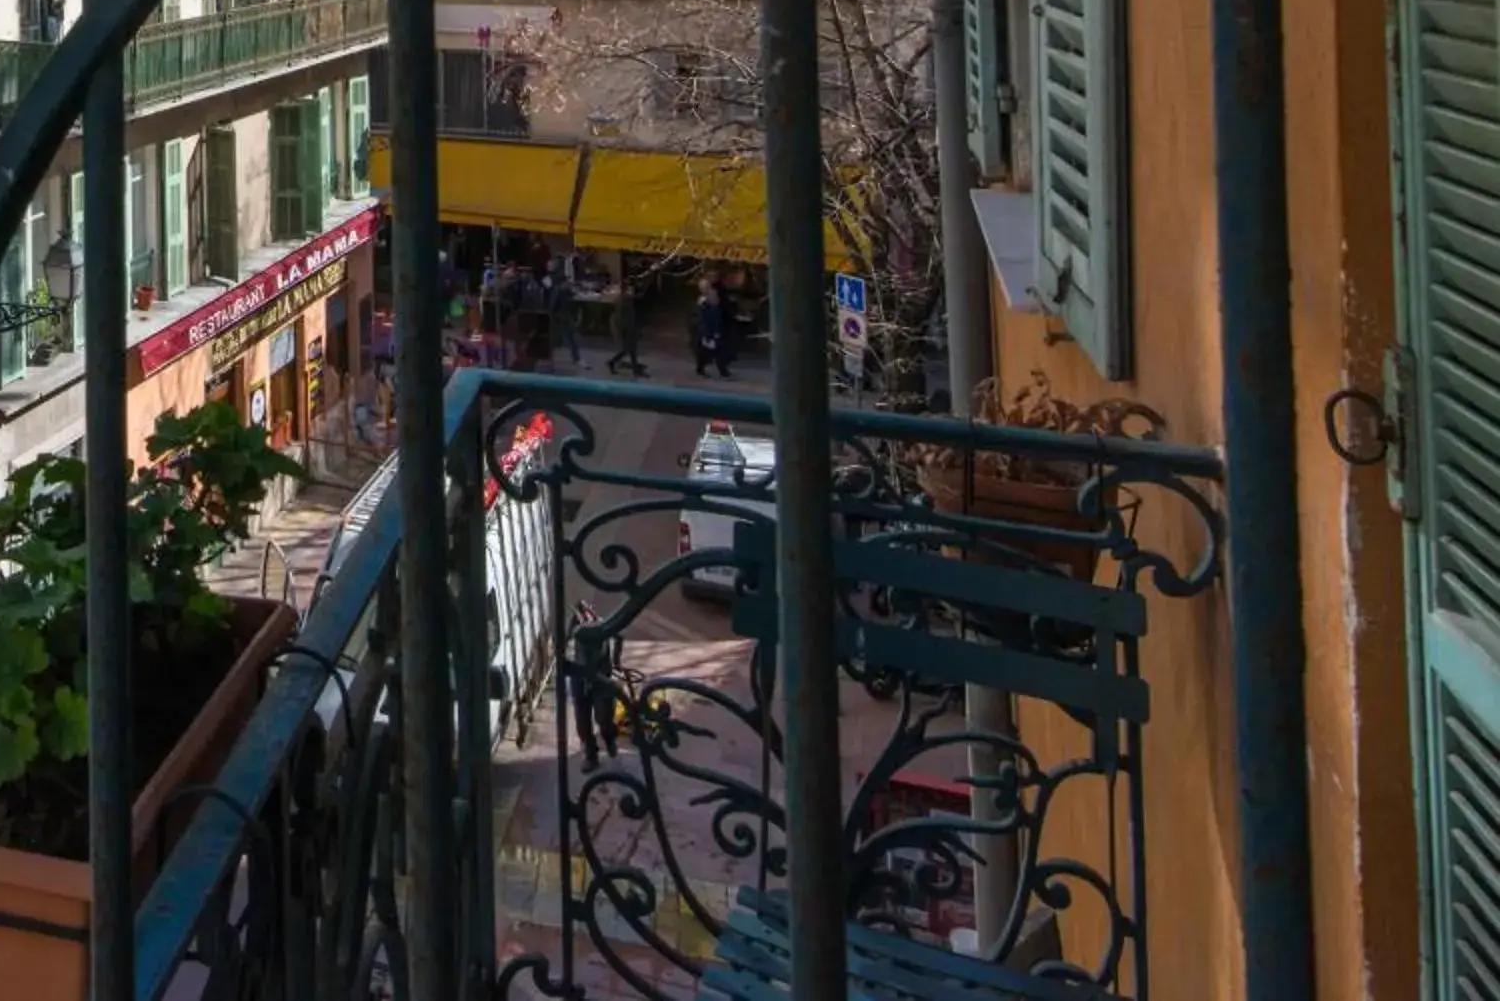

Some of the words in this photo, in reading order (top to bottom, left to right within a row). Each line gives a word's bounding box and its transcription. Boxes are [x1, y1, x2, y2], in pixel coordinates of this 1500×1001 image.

[188, 282, 265, 345] RESTAURANT
[277, 263, 302, 289] LA
[307, 230, 358, 270] MAMA
